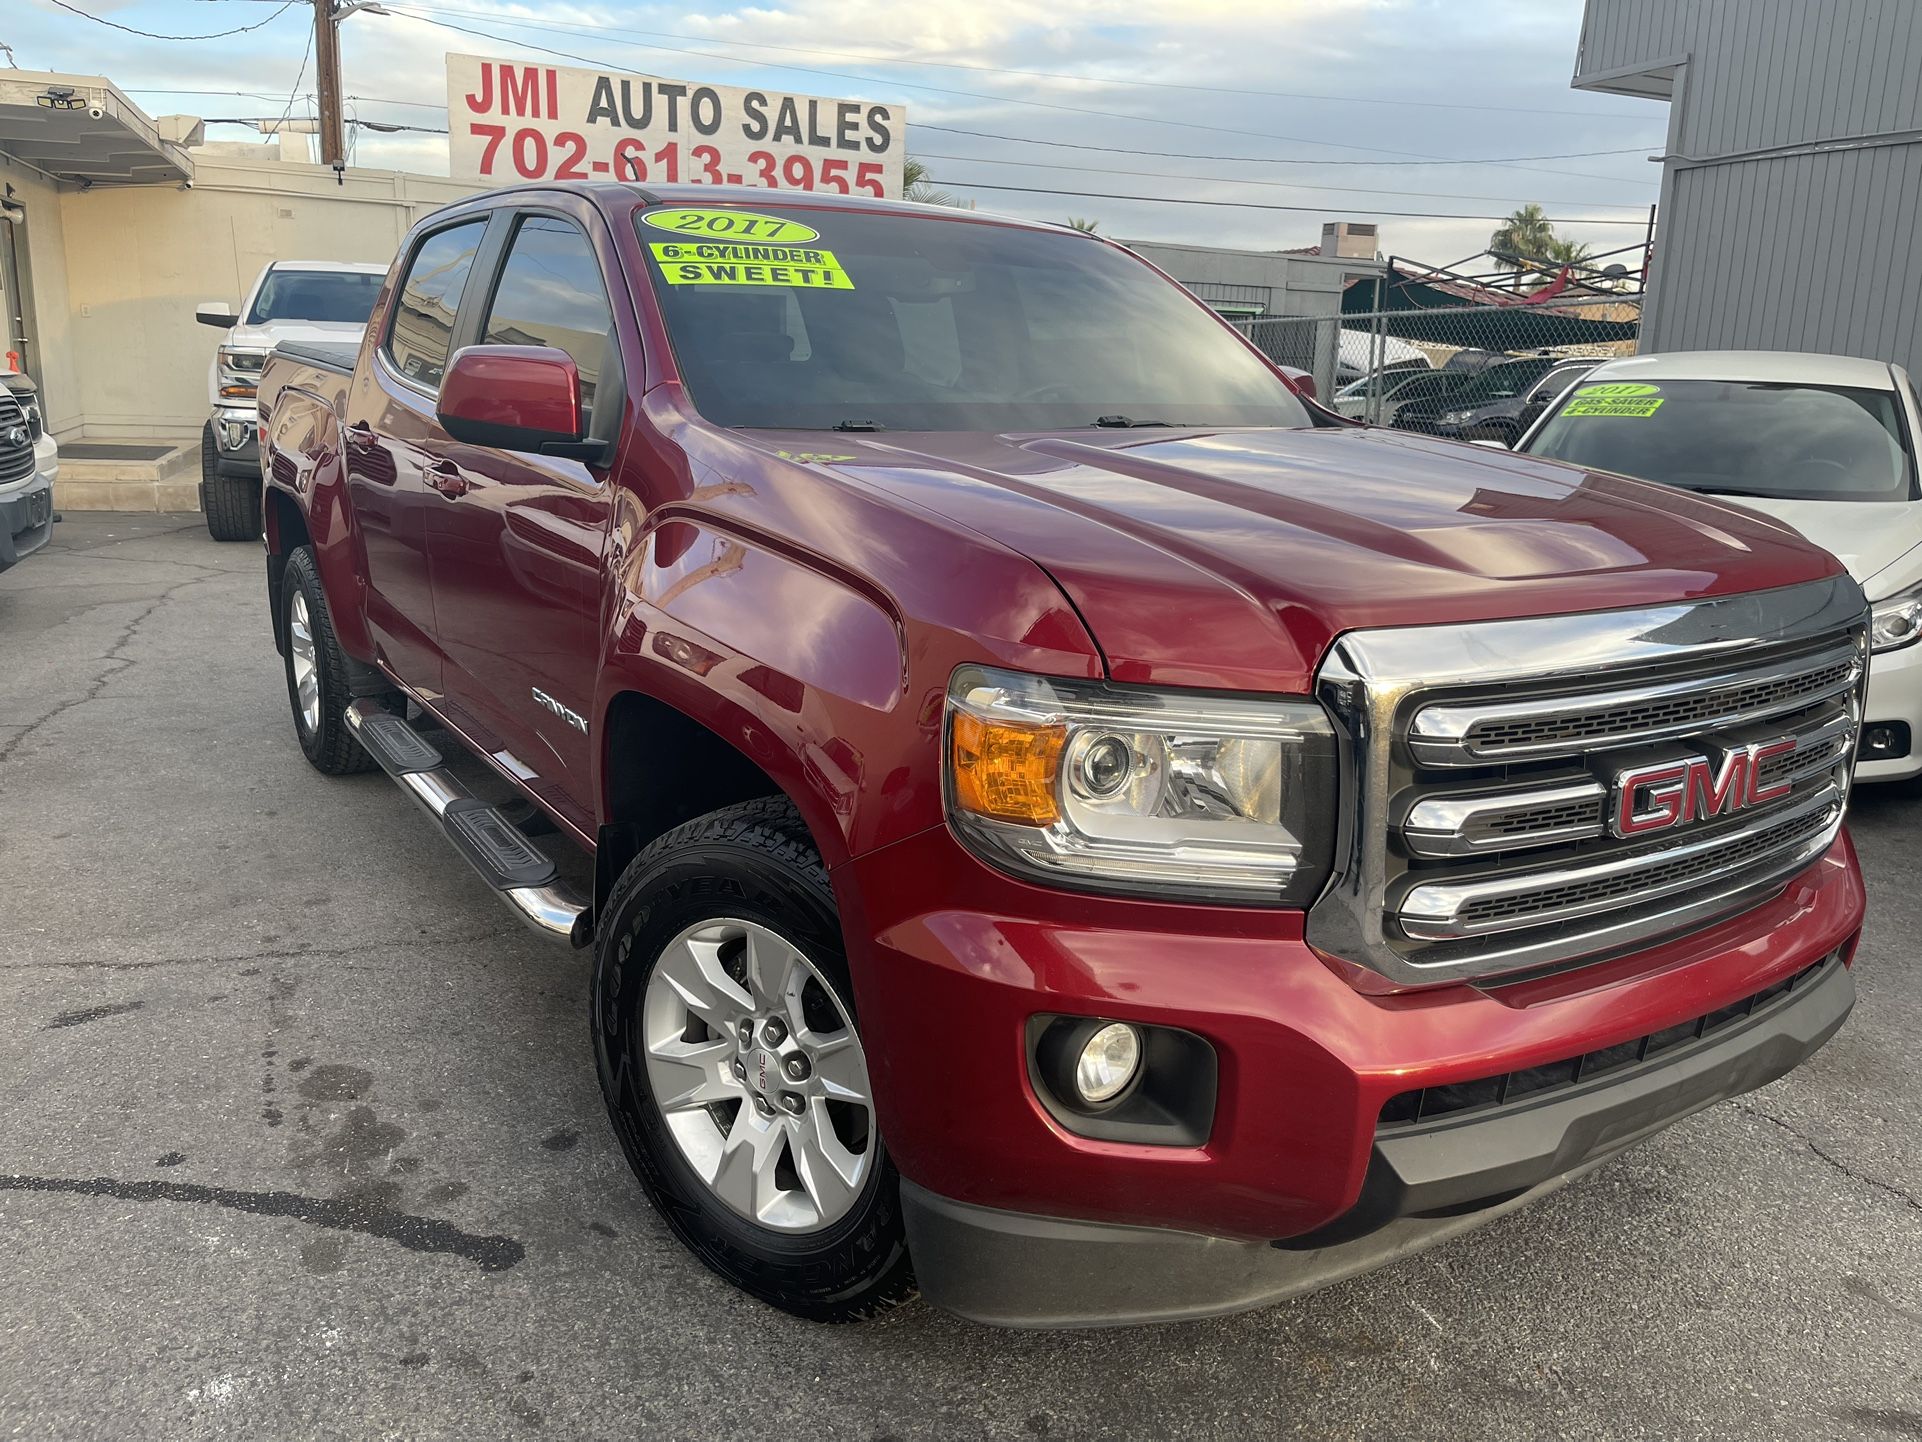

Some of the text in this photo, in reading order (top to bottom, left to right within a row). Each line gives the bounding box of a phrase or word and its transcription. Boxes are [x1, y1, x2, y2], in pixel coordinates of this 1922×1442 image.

[465, 62, 891, 154] JMI AUTO SALES
[469, 122, 885, 199] 702-613-3955
[674, 214, 788, 238] 2017
[661, 244, 825, 265] 6-CYLINDER
[678, 264, 835, 286] SWEET!
[531, 686, 589, 736] CANYON
[1610, 734, 1798, 840] GMC
[759, 1052, 767, 1090] GMC
